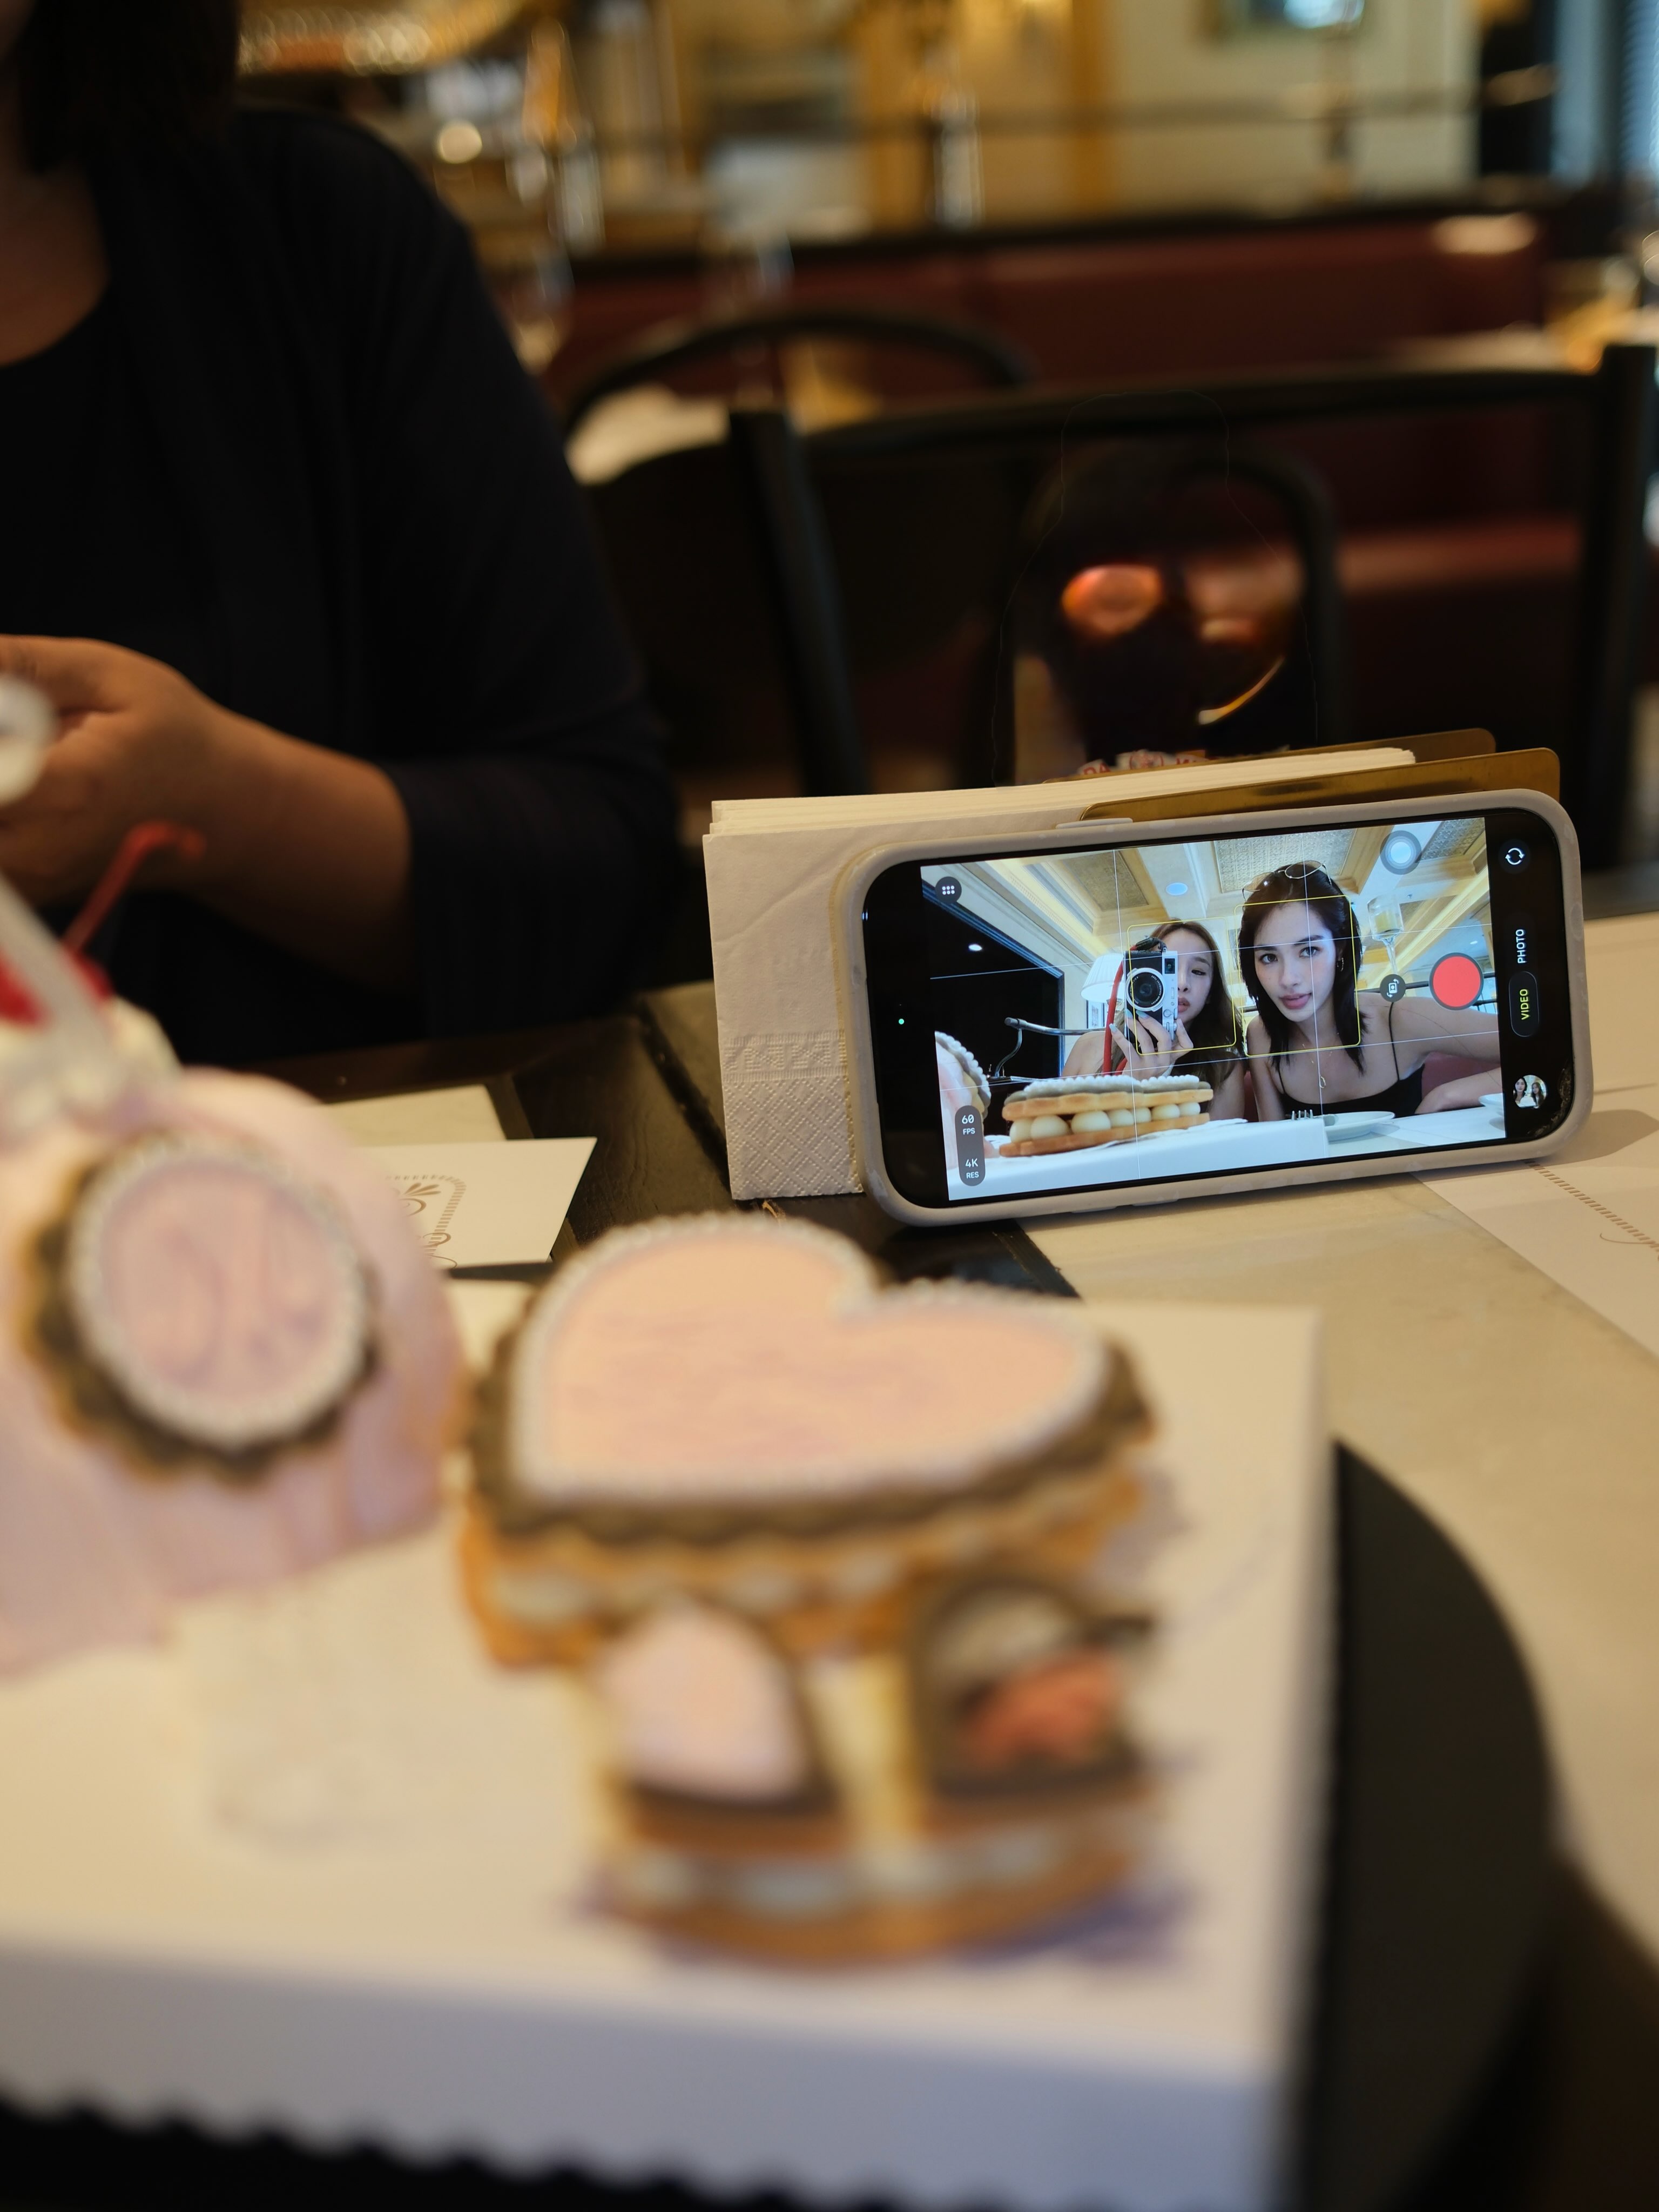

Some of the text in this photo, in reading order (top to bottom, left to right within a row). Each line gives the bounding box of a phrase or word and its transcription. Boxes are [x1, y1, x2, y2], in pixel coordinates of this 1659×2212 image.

[1515, 929, 1526, 963] PHOTO
[1520, 989, 1530, 1020] VIDEO
[962, 1114, 974, 1124] 60
[965, 1158, 979, 1168] 4K
